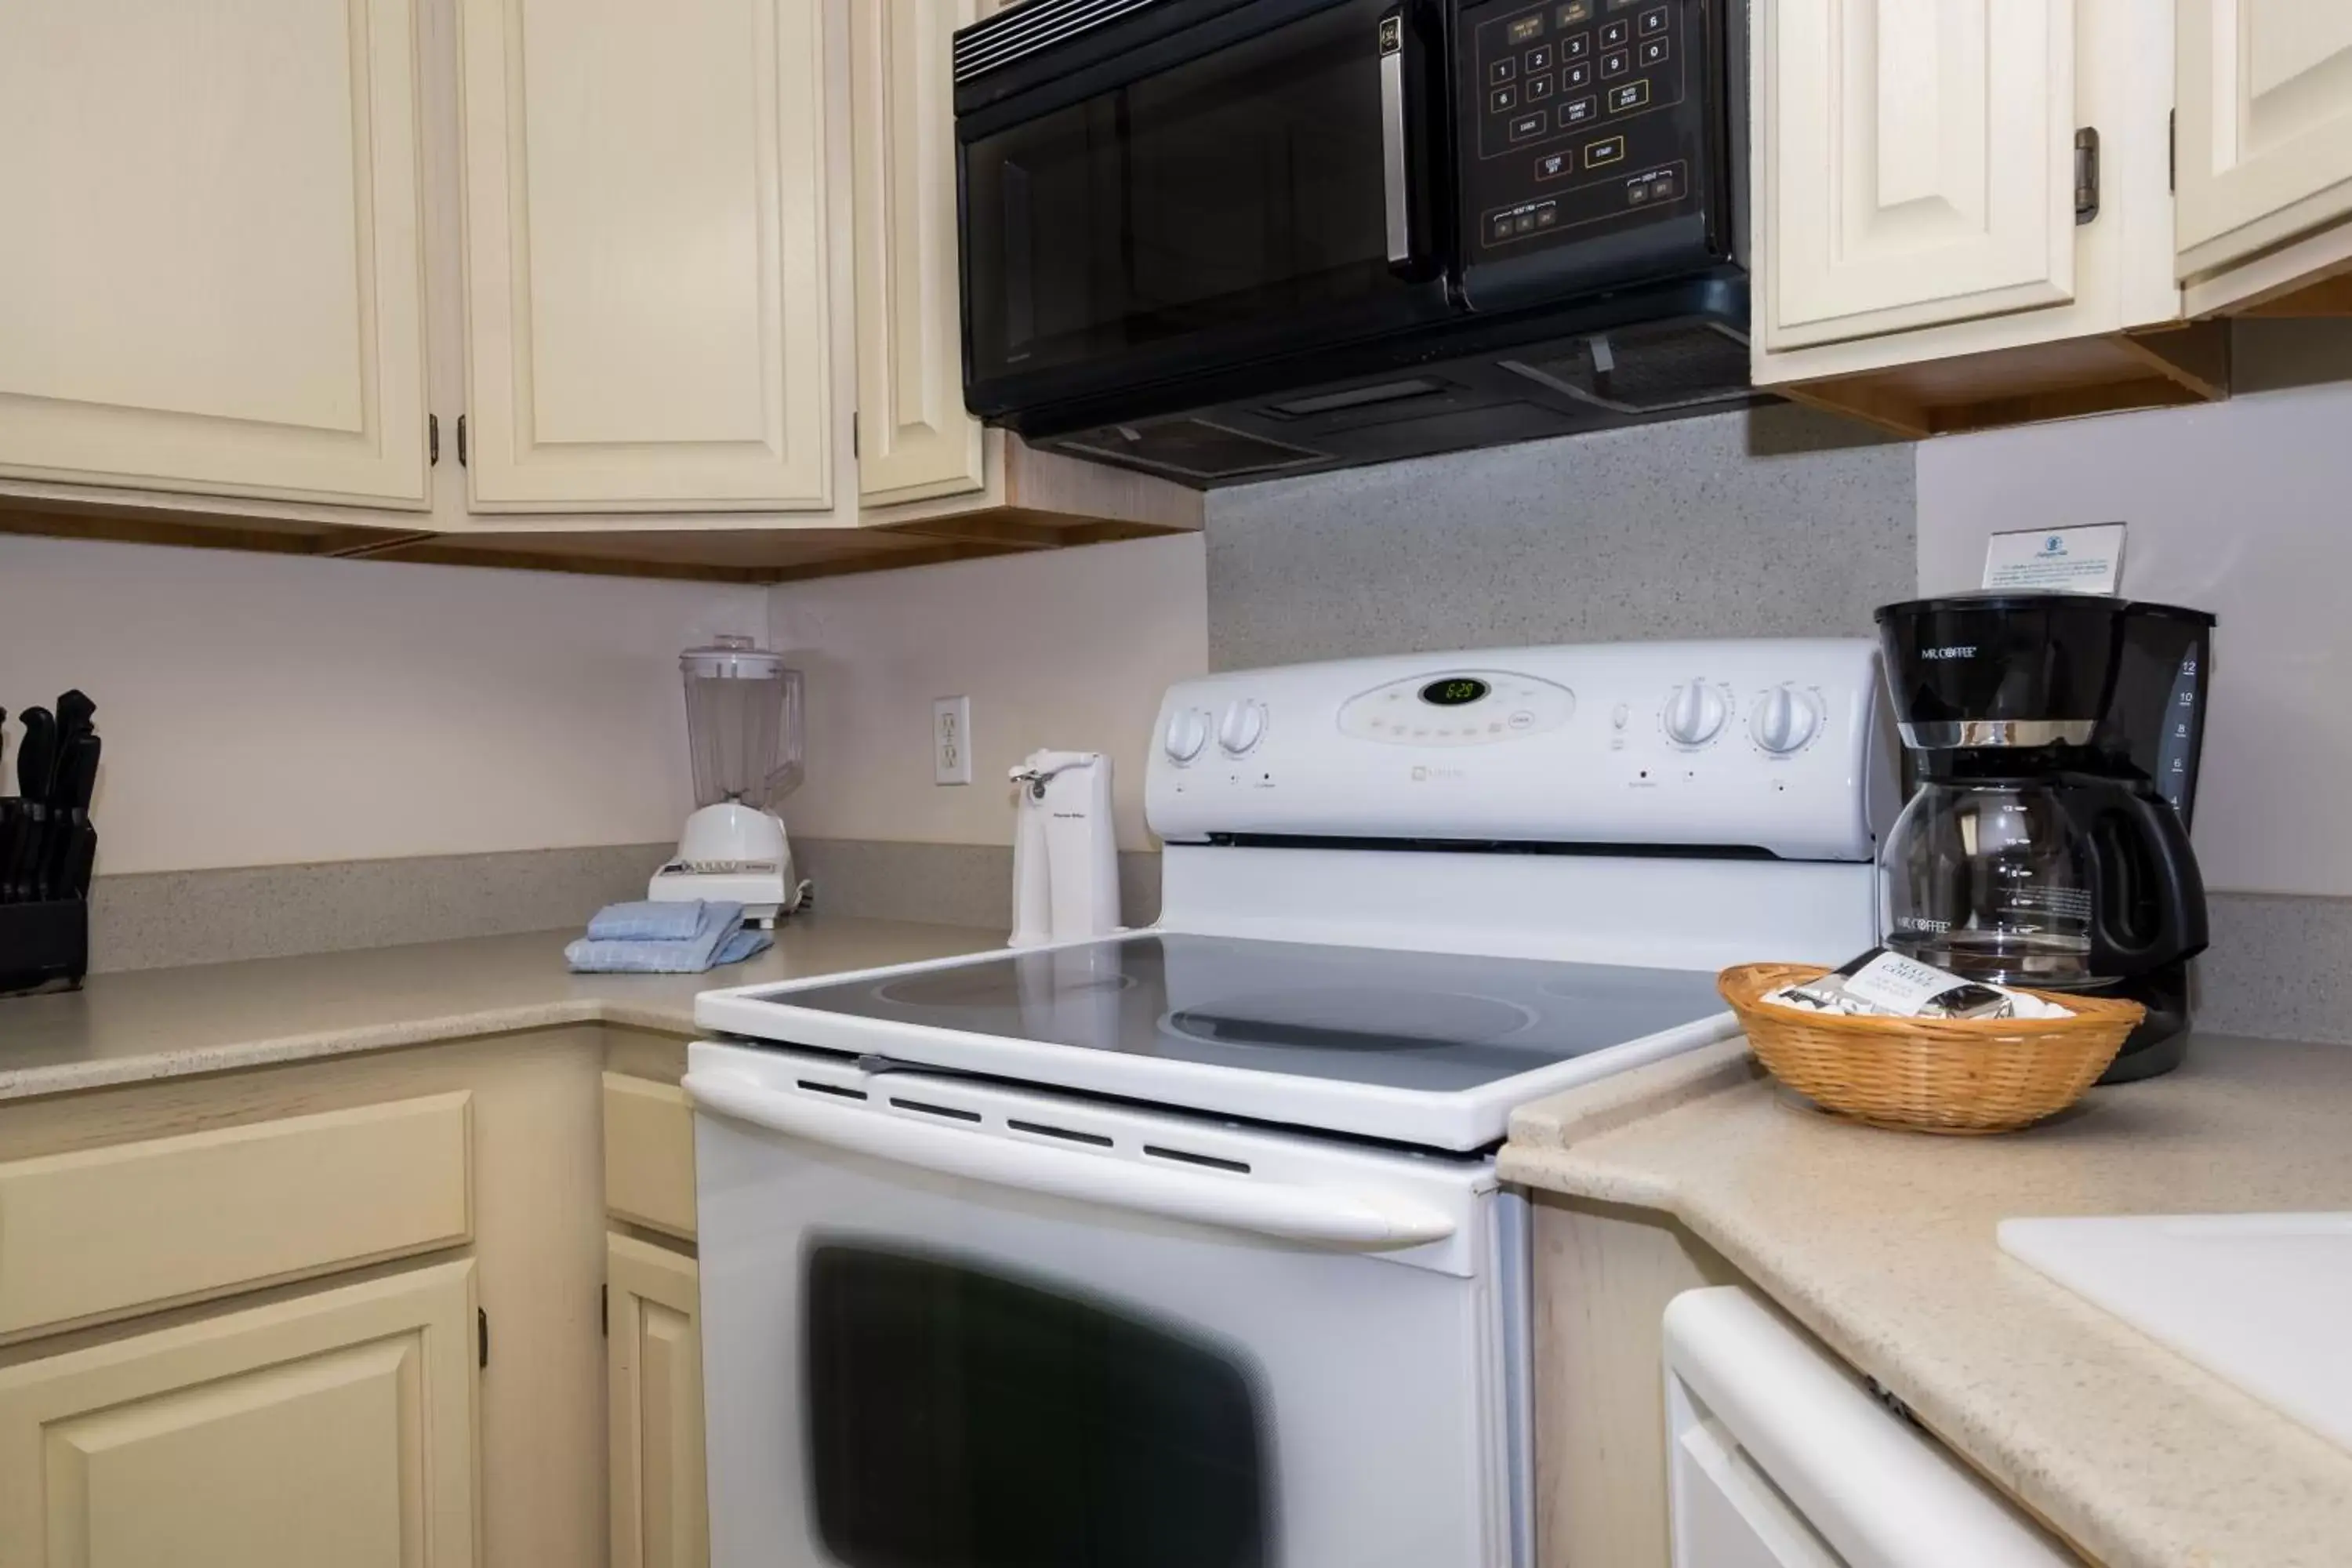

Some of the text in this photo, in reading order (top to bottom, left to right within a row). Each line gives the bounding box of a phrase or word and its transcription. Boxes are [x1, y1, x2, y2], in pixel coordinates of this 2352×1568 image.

[1500, 66, 1505, 76] 1
[1536, 54, 1543, 65] 2
[1572, 42, 1580, 53] 3
[1610, 29, 1617, 39] 4
[1500, 46, 1658, 104] 6 7 8 9 0
[1938, 647, 1976, 659] COFFEE
[2183, 660, 2196, 672] 12
[2180, 692, 2193, 704] 10
[2177, 724, 2186, 734] 8
[1911, 918, 1949, 934] COFFEE
